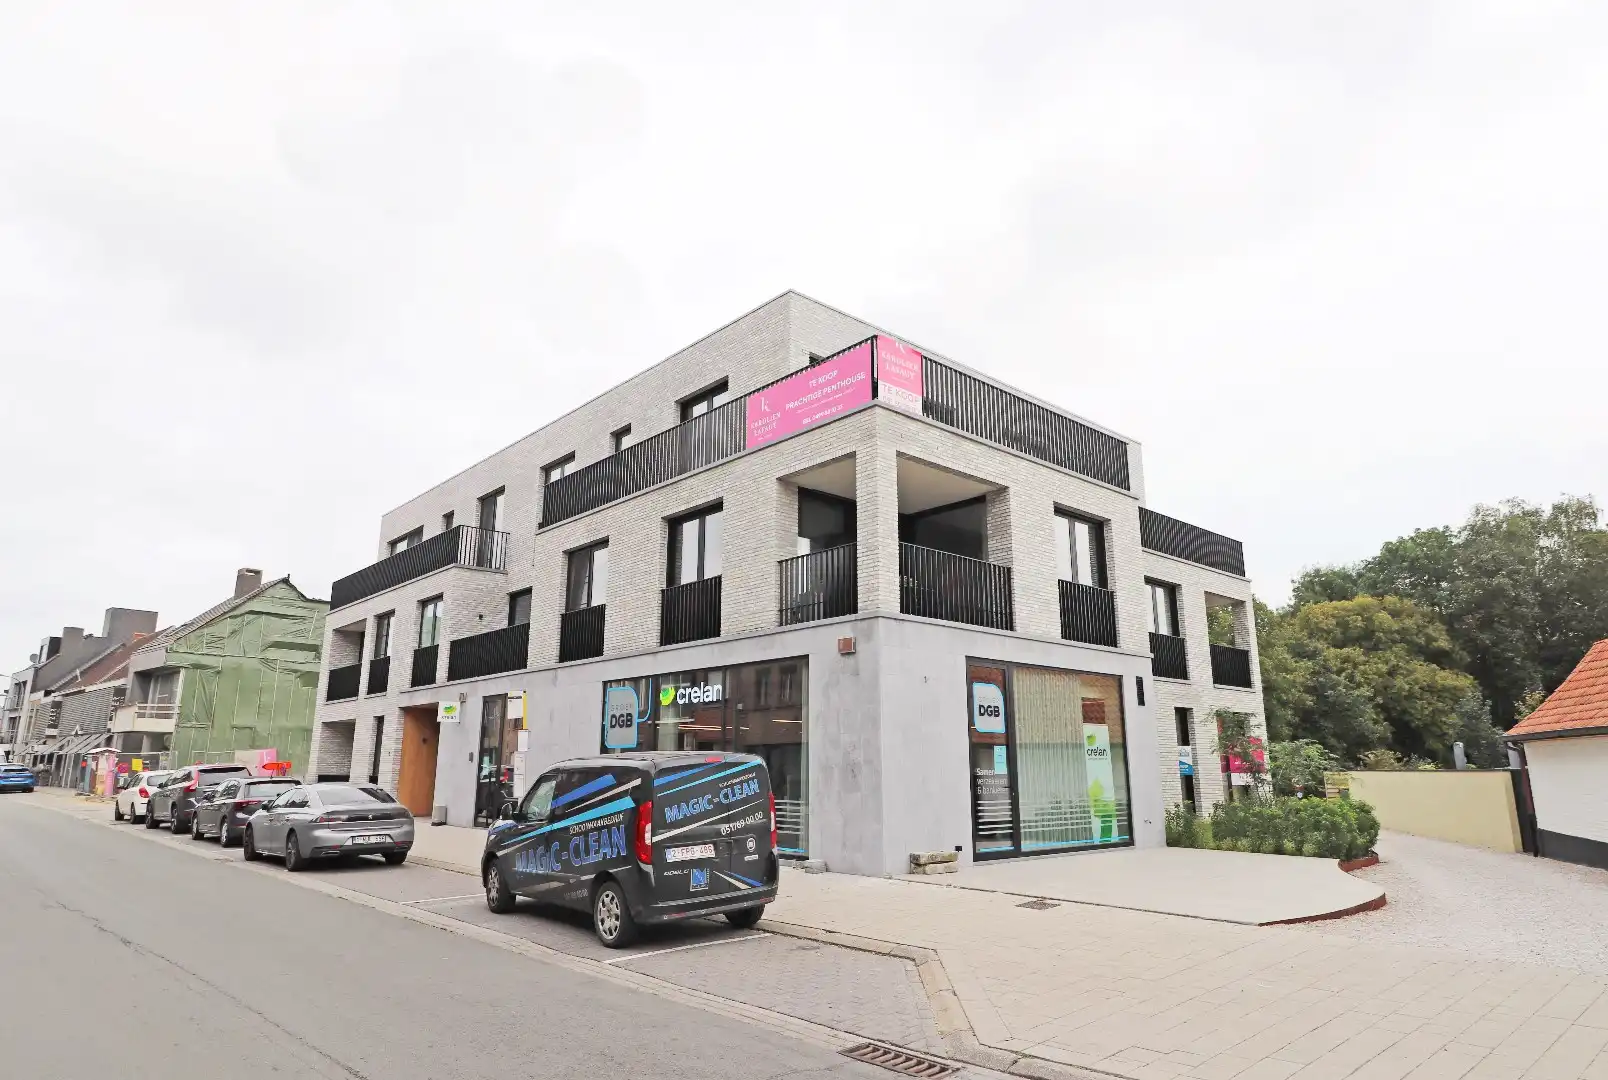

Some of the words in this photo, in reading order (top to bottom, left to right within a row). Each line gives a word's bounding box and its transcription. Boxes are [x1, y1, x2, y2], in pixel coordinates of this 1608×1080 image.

[822, 371, 866, 395] PENTHOUSE
[676, 682, 723, 705] crelan
[978, 704, 1000, 718] DGB
[610, 712, 633, 728] DGB
[1086, 746, 1108, 757] crelan
